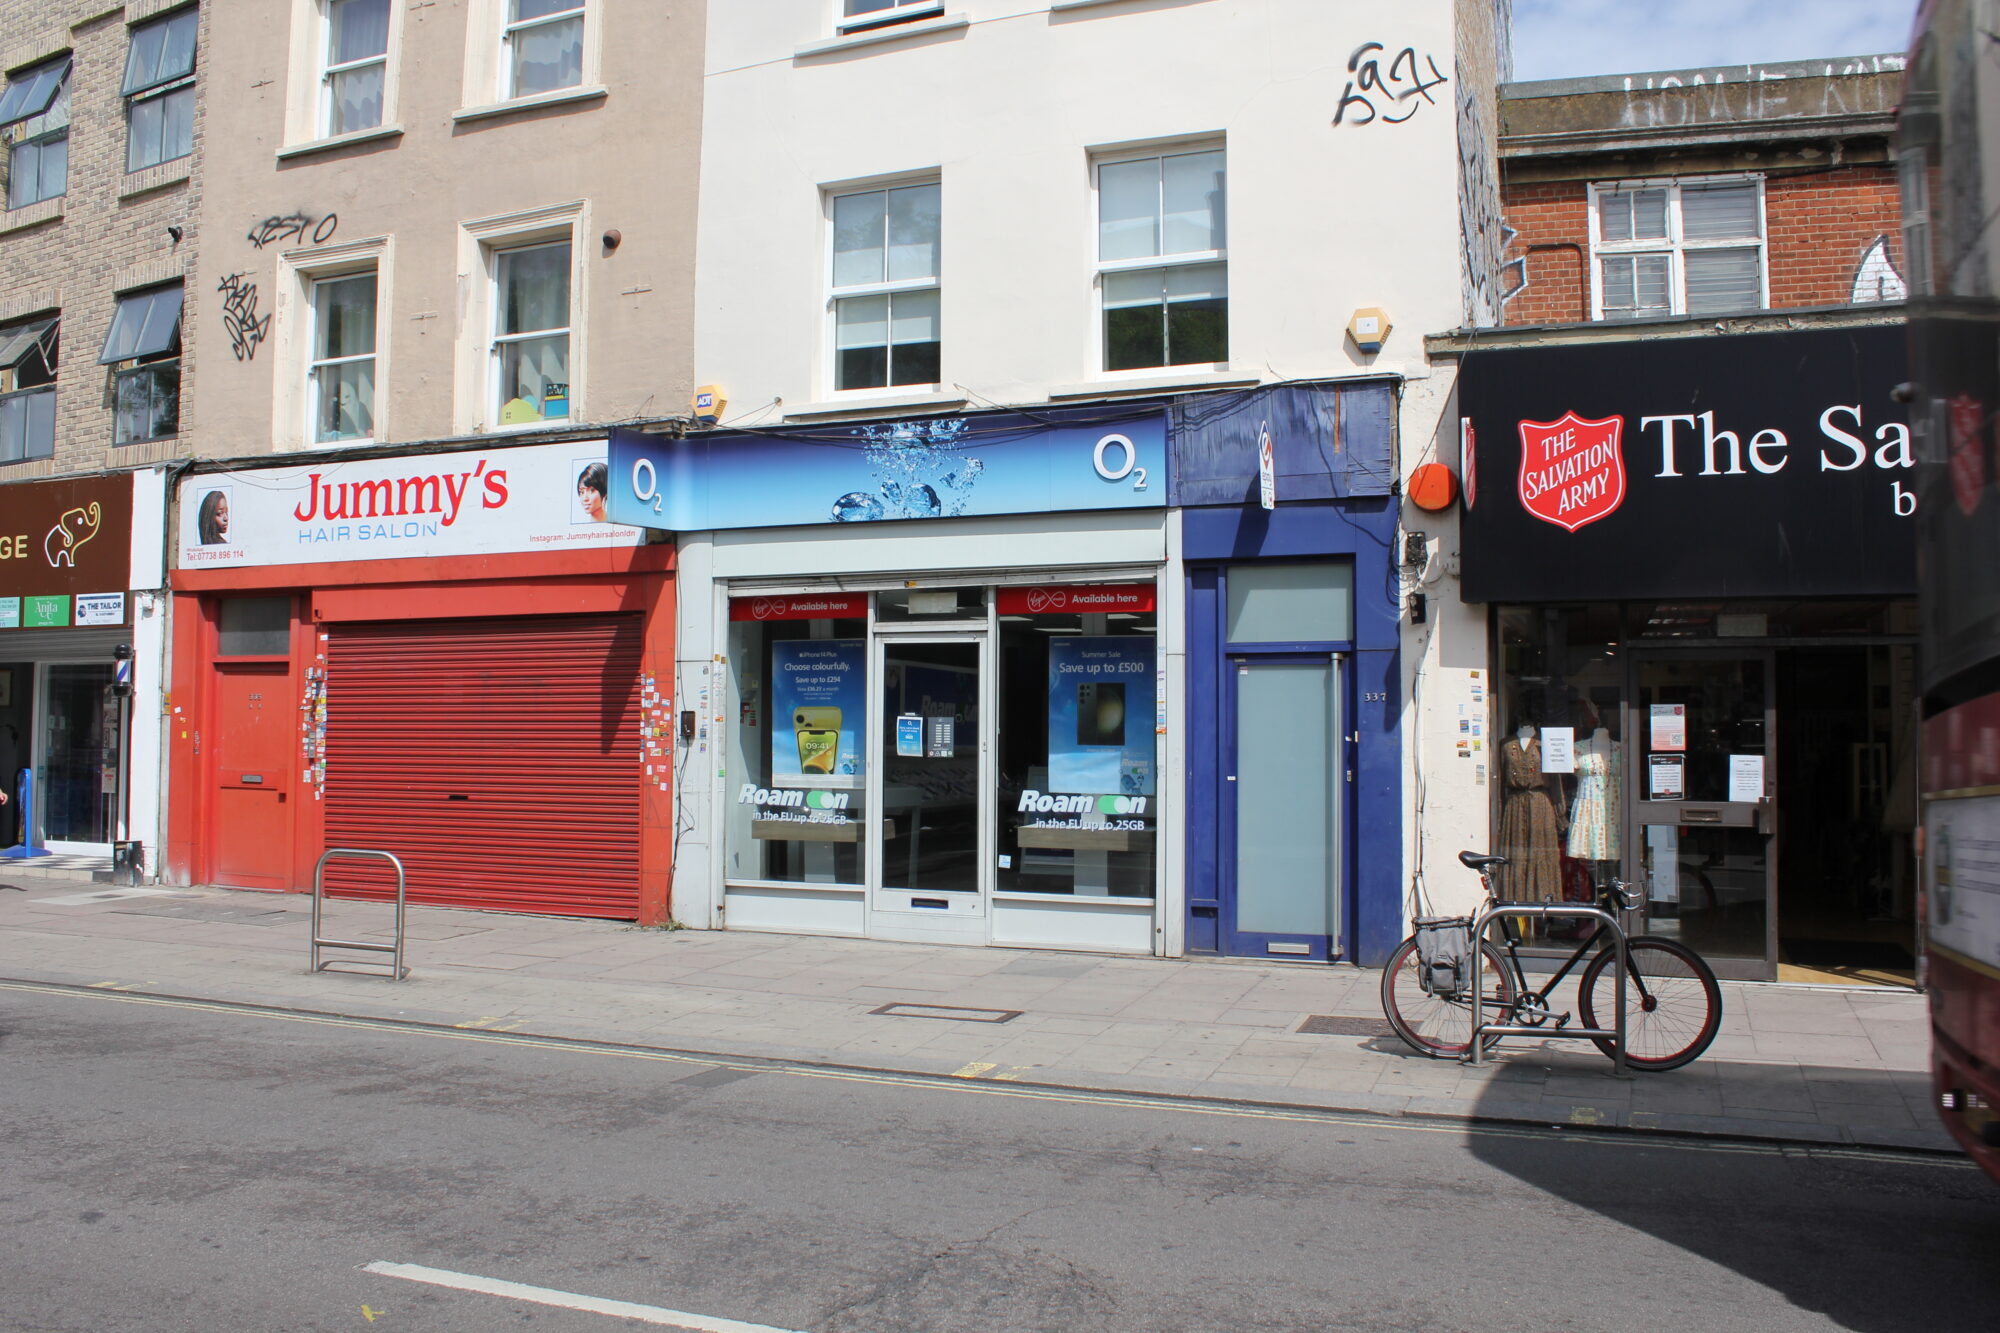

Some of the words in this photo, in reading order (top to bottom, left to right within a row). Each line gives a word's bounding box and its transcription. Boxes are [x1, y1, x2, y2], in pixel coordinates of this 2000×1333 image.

[697, 394, 711, 407] ADT
[1541, 428, 1576, 461] THE
[1640, 409, 1788, 478] The
[1093, 433, 1147, 488] O2
[1525, 433, 1614, 500] SALVATION
[632, 458, 662, 512] O2
[1557, 467, 1610, 516] ARMY
[293, 459, 509, 527] Jummy's
[299, 526, 351, 544] HAIR
[358, 522, 437, 541] SALON
[529, 534, 564, 543] Instagram:
[219, 551, 231, 560] 896
[233, 550, 244, 558] 114
[100, 602, 122, 610] TAILOR
[1072, 594, 1115, 604] Available
[1117, 594, 1138, 602] here
[791, 602, 828, 612] Available
[829, 601, 848, 610] here
[784, 663, 810, 671] Choose
[811, 662, 850, 672] colourfully.
[1059, 663, 1083, 673] Save
[1087, 665, 1100, 675] up
[1104, 664, 1115, 673] to
[1118, 662, 1144, 673] £500
[1364, 692, 1386, 702] 337
[738, 783, 804, 806] Roam
[1017, 789, 1094, 813] Roam
[752, 810, 760, 819] in
[763, 810, 778, 820] the
[781, 812, 793, 821] EU
[794, 814, 806, 824] up
[809, 814, 818, 822] to
[822, 815, 847, 824] 25GB
[1035, 818, 1045, 828] in
[1048, 818, 1066, 829] the
[1068, 819, 1082, 829] EU
[1084, 820, 1097, 831] up
[1101, 820, 1113, 830] to
[1116, 820, 1145, 830] 25GB
